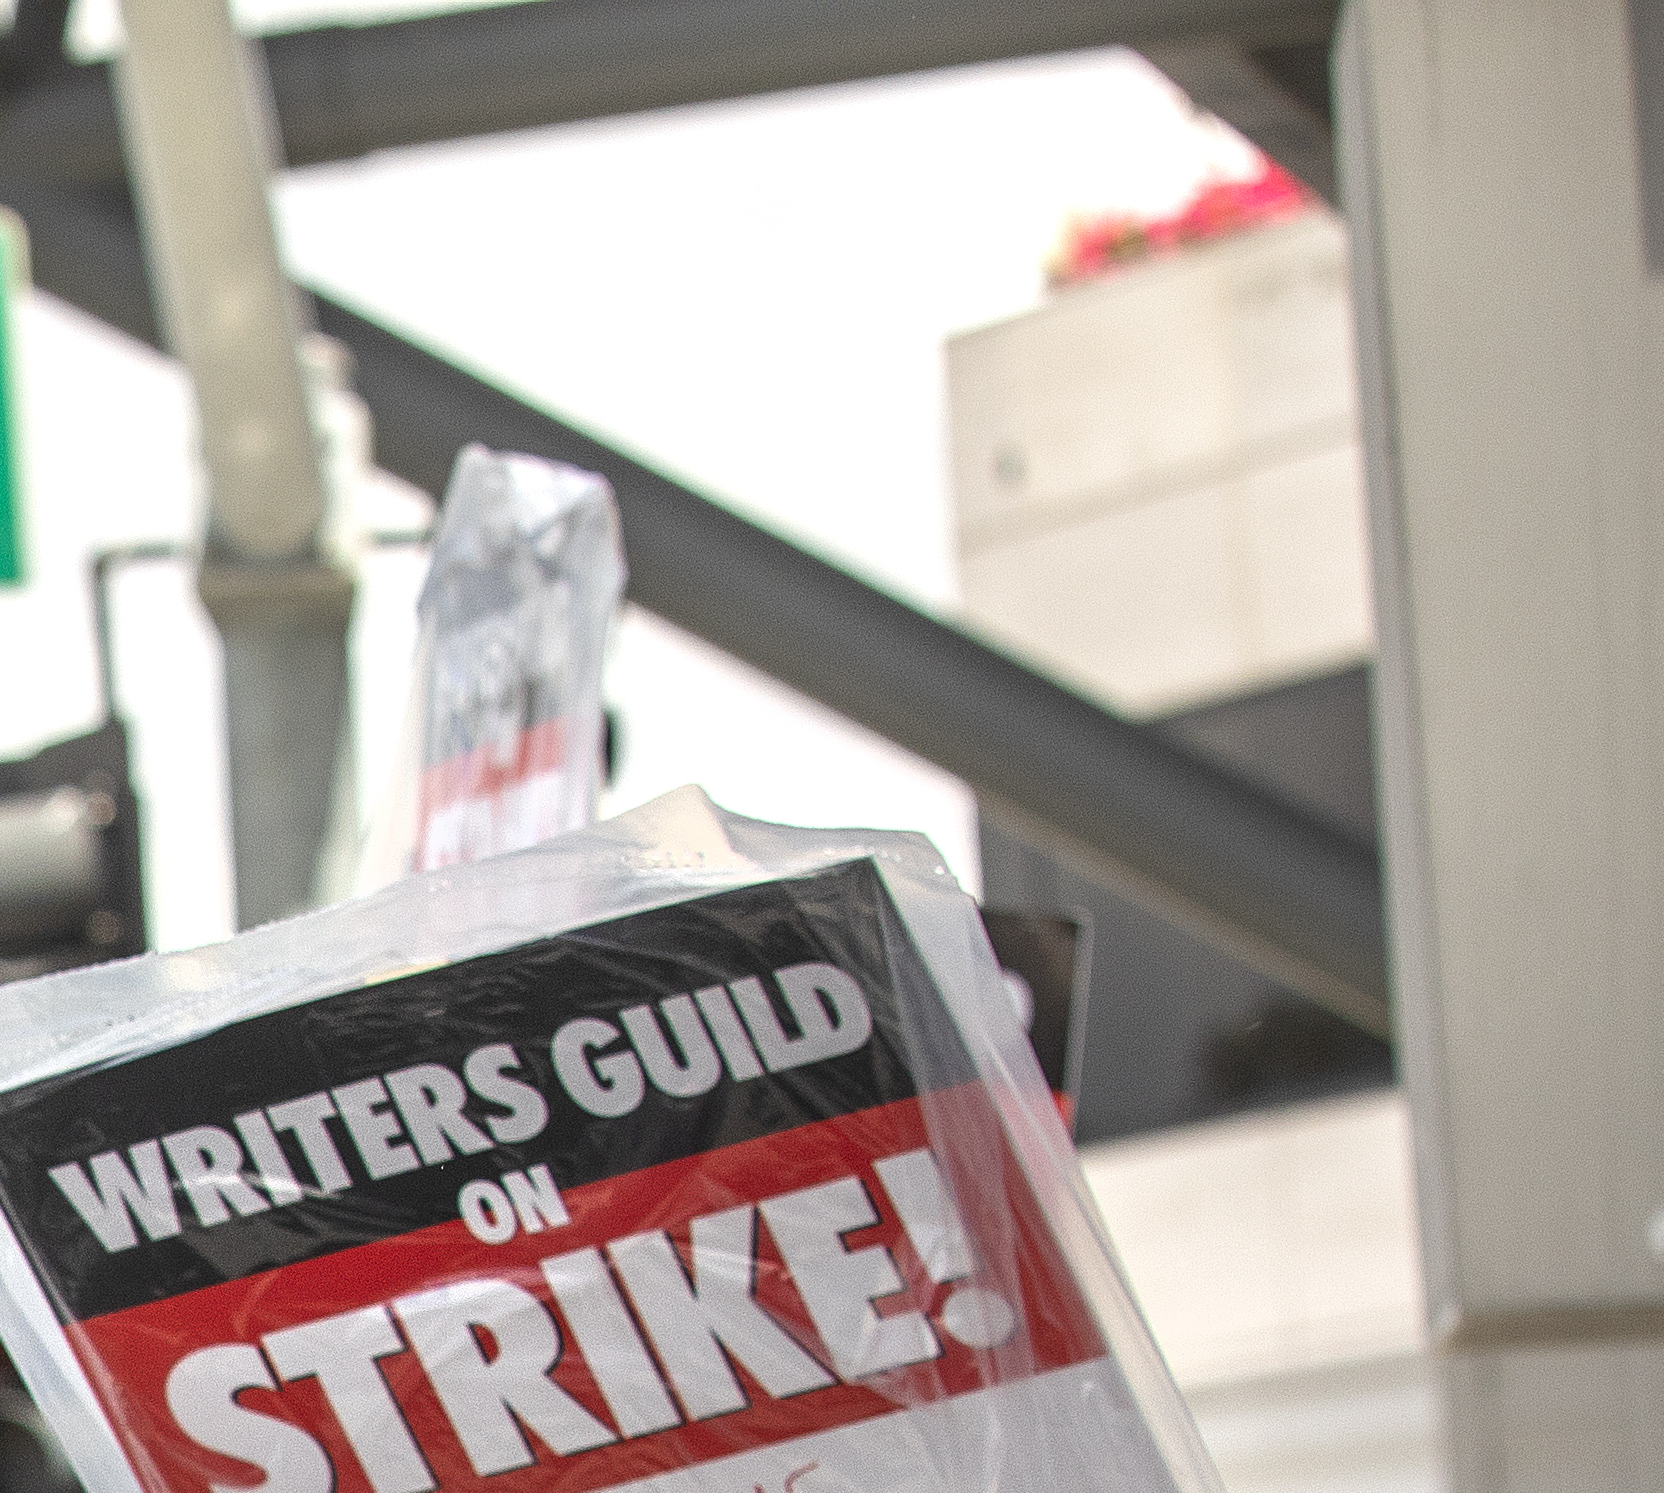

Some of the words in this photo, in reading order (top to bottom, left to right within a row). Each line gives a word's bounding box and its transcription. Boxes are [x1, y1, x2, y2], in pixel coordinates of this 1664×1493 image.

[50, 1043, 549, 1256] WRITERS
[550, 959, 876, 1123] GUILD
[457, 1165, 570, 1248] ON
